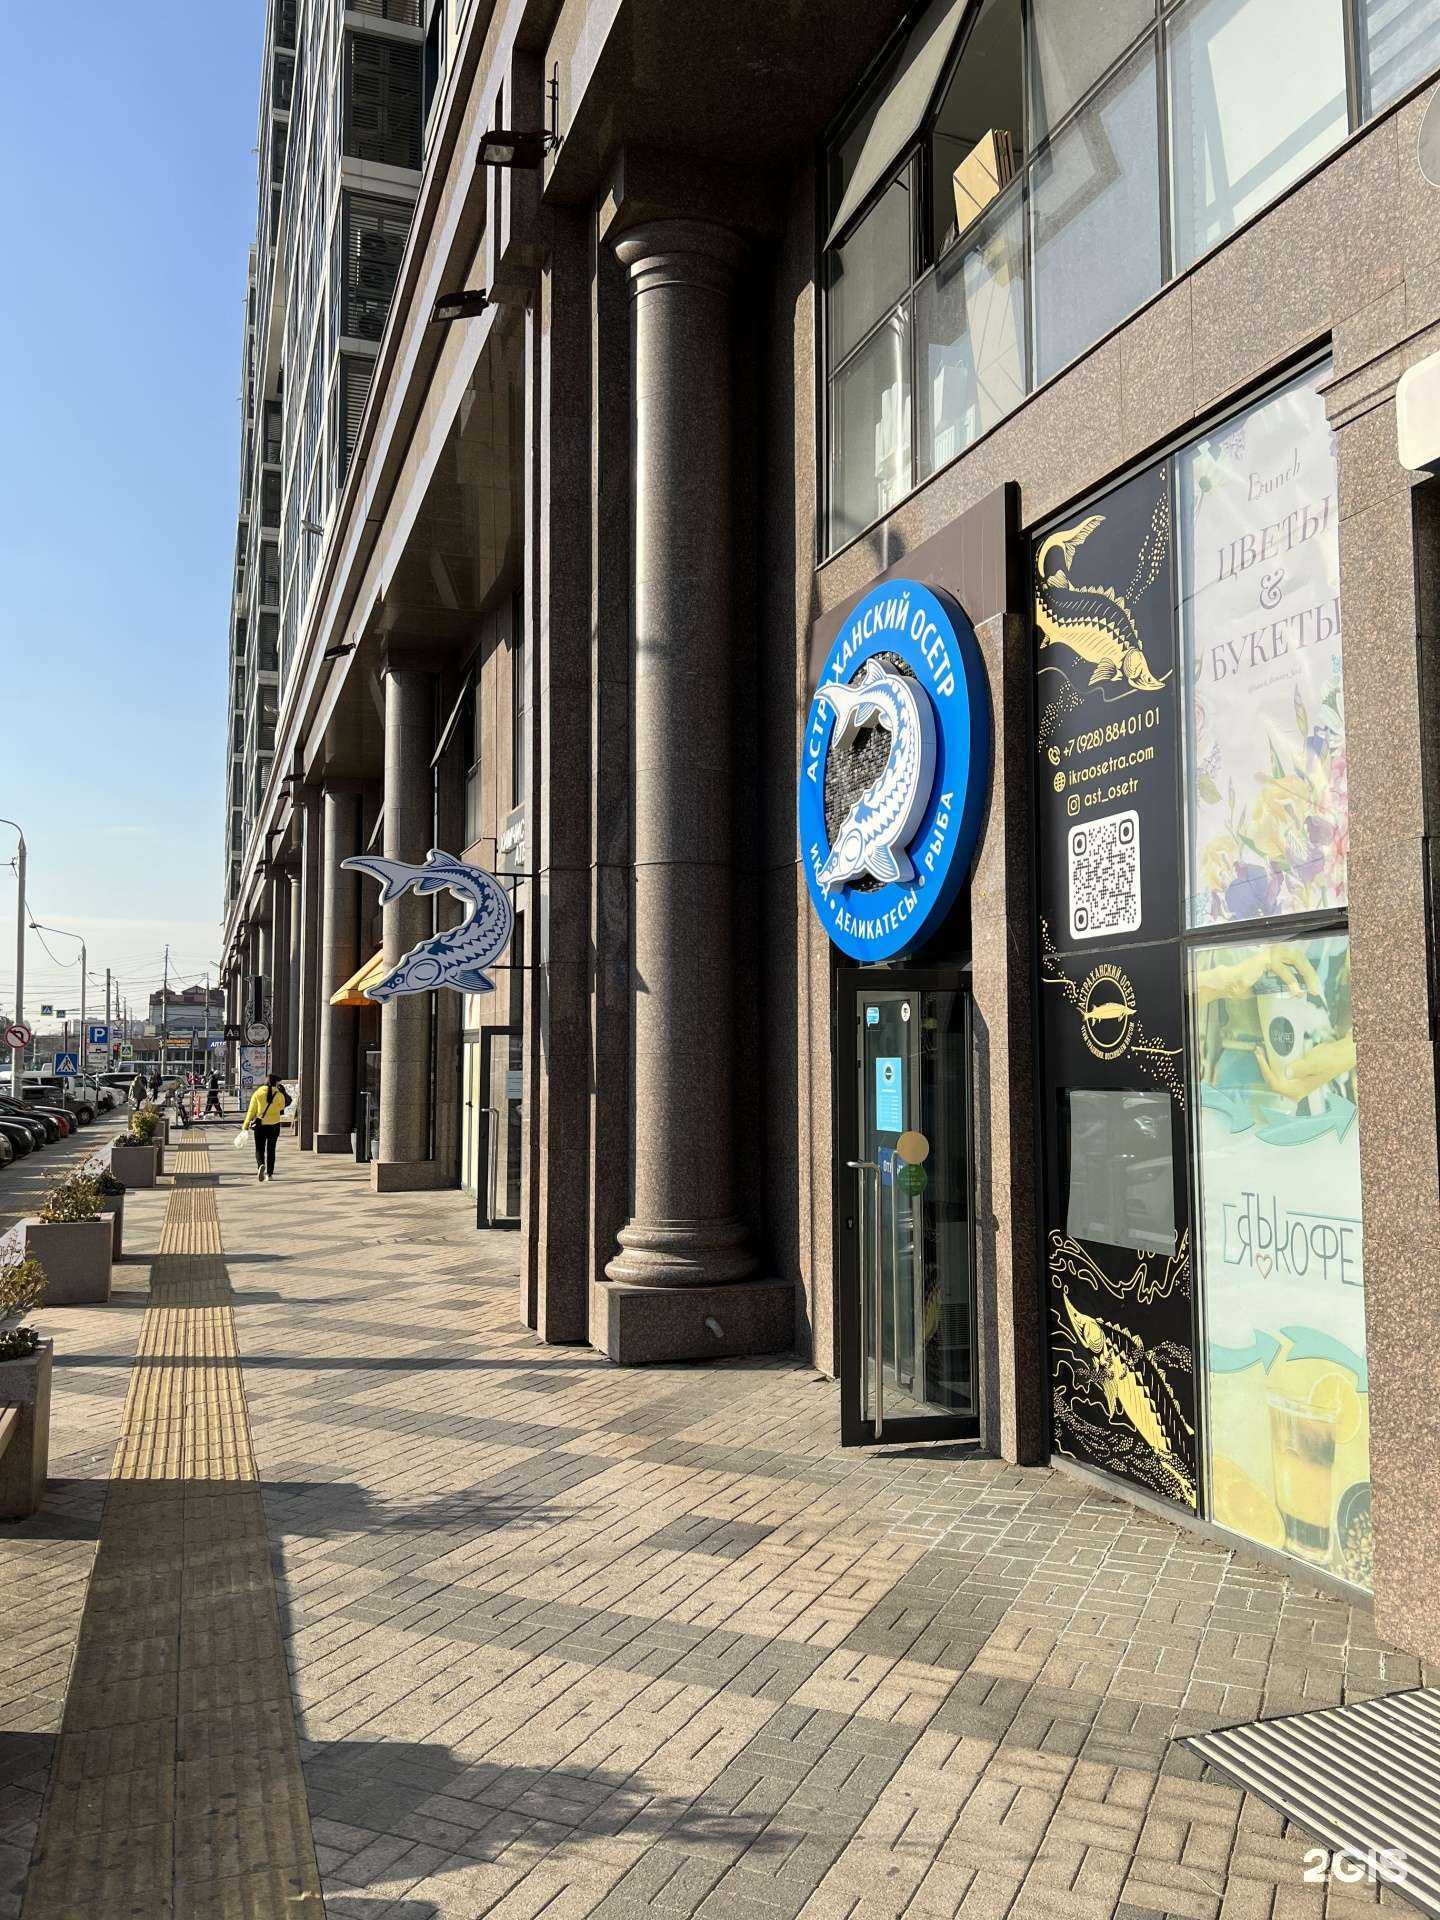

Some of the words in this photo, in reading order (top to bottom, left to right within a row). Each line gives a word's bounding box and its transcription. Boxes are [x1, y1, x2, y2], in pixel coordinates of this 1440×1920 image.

[1217, 494, 1332, 582] ЦВЕТЫ
[1259, 568, 1285, 610] &
[1209, 596, 1341, 682] БУКЕТЫ
[807, 591, 910, 783] АСТРХАНСКИЙ
[910, 608, 955, 697] ОСЕТР
[1063, 738, 1075, 757] +7
[1076, 727, 1104, 754] (928)
[1068, 746, 1154, 786] ikraosetra.com
[1084, 777, 1138, 806] ast_osetr
[834, 887, 918, 940] ДЕЛИКАТЕСЫ
[924, 791, 953, 872] РЫБА
[1078, 963, 1122, 1008] АСТРАХАНСКИЙ
[1119, 974, 1136, 1007] ОСЕТР
